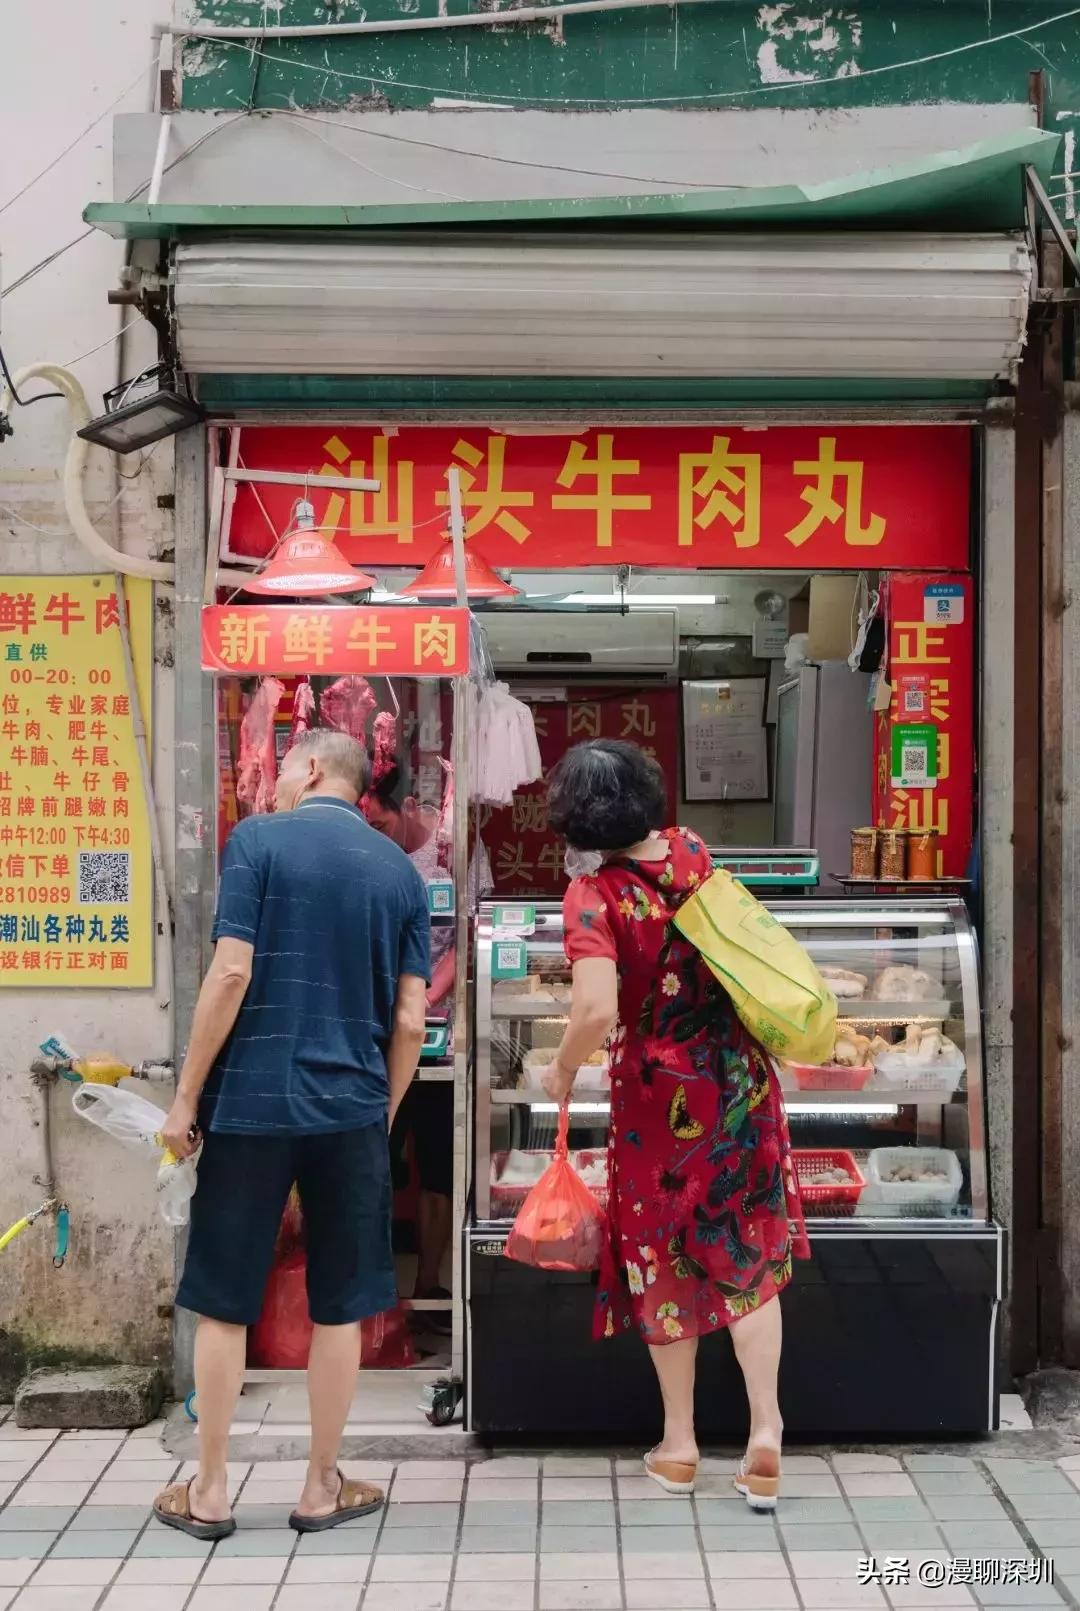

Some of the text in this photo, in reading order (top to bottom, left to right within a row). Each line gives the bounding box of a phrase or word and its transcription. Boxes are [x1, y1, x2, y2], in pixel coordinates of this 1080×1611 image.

[318, 434, 887, 549] 汕头牛肉丸
[0, 592, 130, 635] 鲜牛肉
[5, 643, 48, 661] 直供
[219, 612, 456, 666] 新鲜牛肉
[1, 825, 130, 847] 中午12:00 下午4:30
[0, 853, 70, 879] 信下单
[0, 913, 129, 944] 潮汕各种丸类
[0, 950, 129, 970] 设银行正对面
